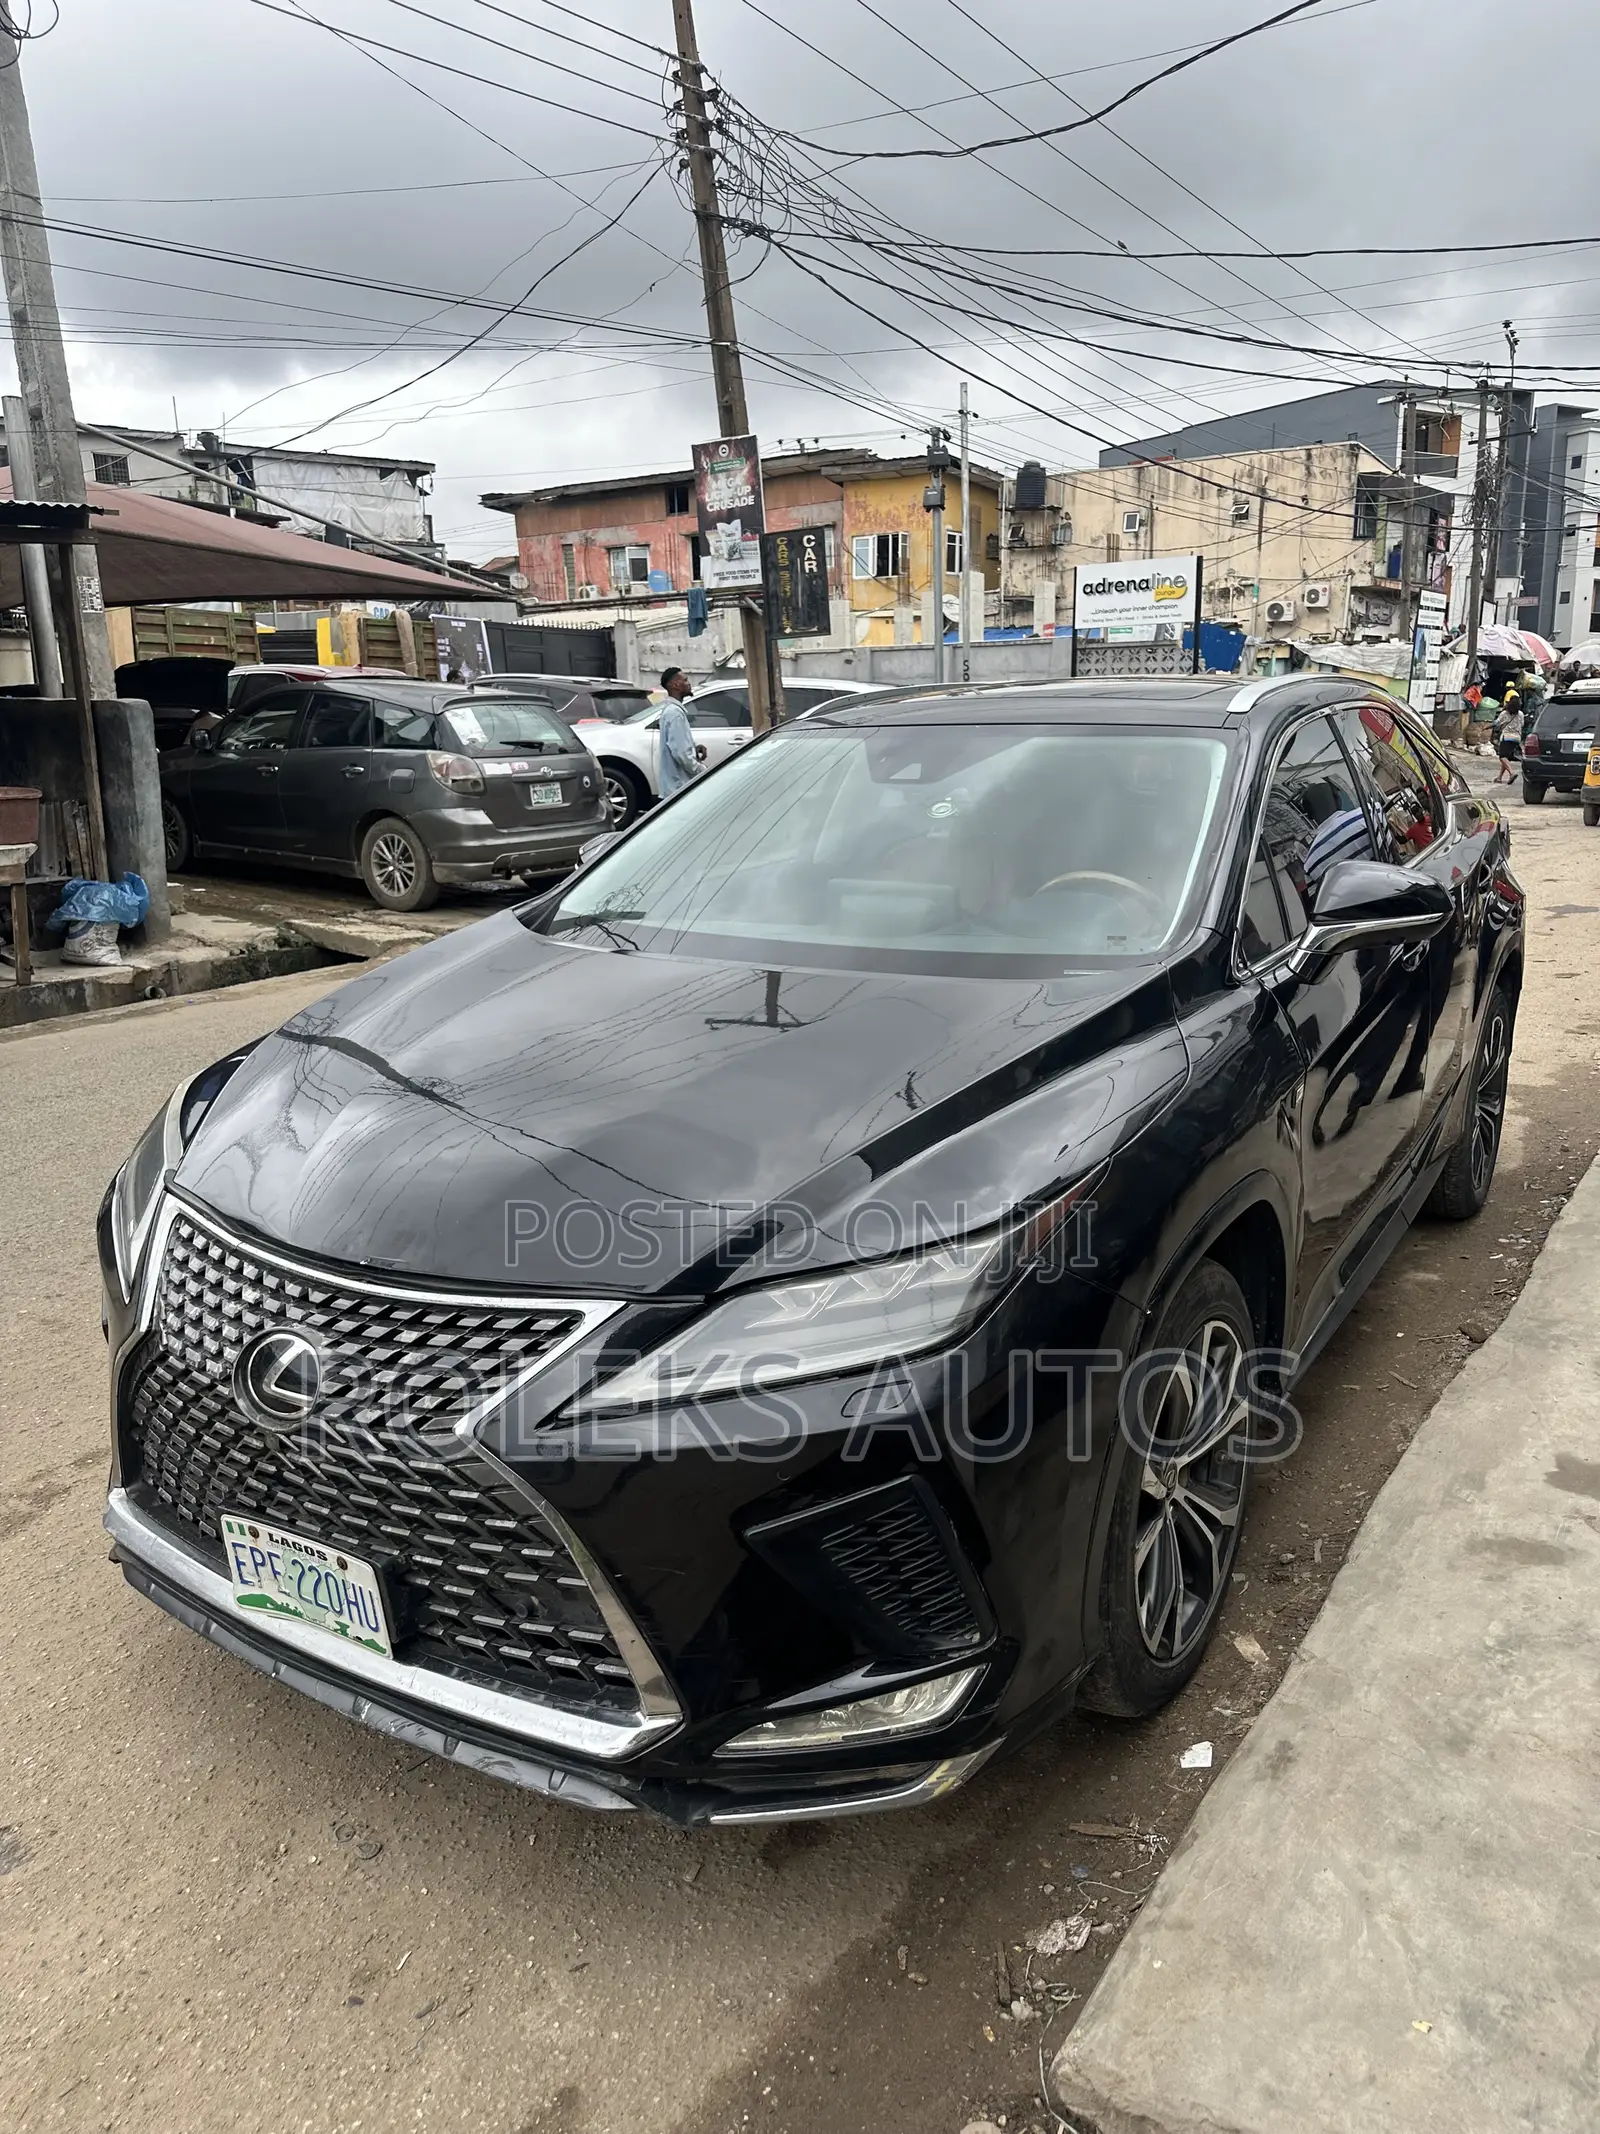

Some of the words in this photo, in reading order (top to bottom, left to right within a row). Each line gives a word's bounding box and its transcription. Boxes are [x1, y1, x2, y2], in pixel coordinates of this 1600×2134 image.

[706, 495, 755, 512] CRUSADE
[802, 534, 818, 574] CAR
[1083, 572, 1187, 597] adrenaline
[1148, 603, 1178, 611] champion
[268, 1532, 328, 1561] LAGOS
